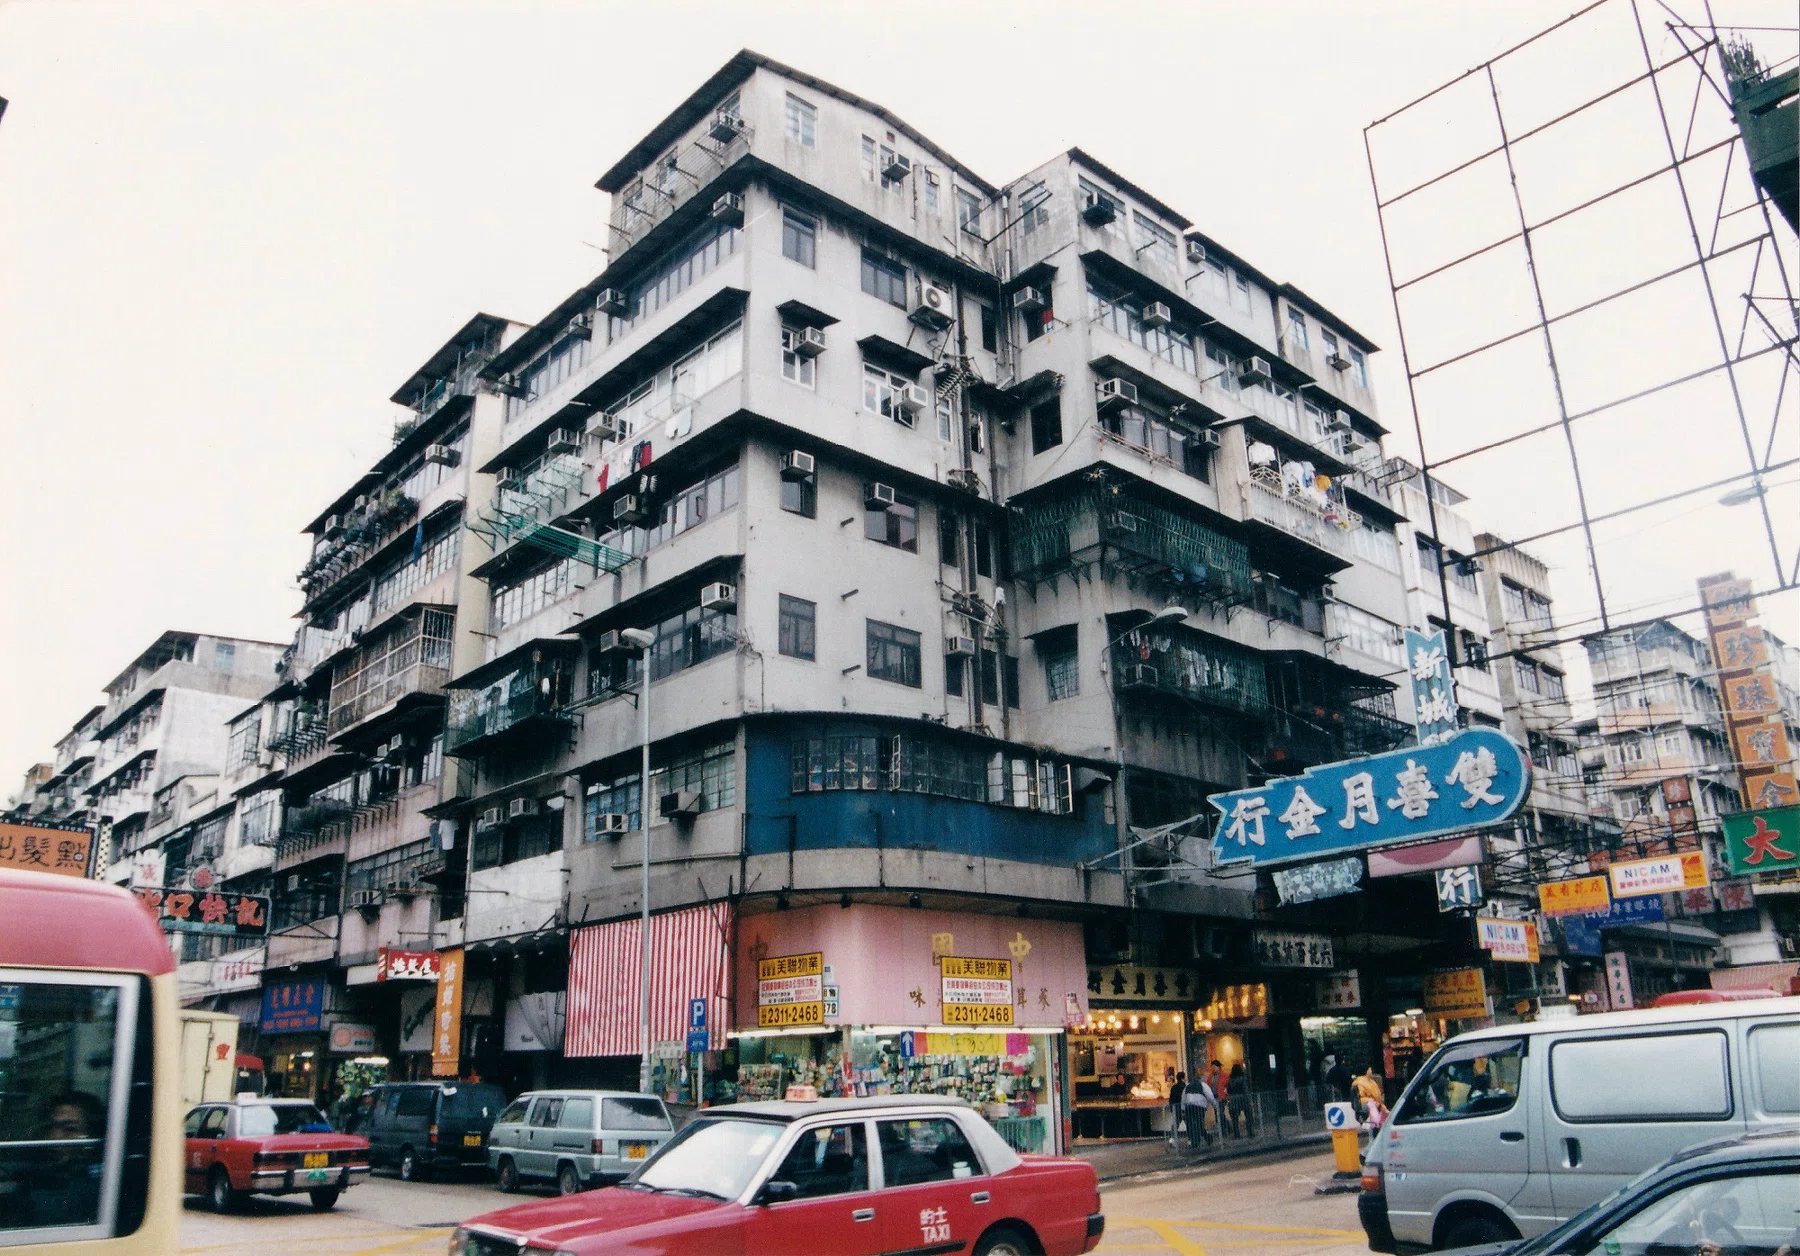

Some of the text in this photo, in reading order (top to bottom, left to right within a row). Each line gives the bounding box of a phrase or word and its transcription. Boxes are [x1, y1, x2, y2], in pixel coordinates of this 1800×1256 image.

[1225, 745, 1505, 847] 雙喜月金行
[1743, 815, 1797, 865] 大
[1624, 864, 1670, 878] NICAM
[1486, 924, 1520, 940] NICAM
[777, 956, 818, 975] 美聯物業
[963, 960, 1007, 976] 美聯物業
[693, 1001, 704, 1025] P
[920, 1206, 948, 1225] 的士
[920, 1224, 951, 1244] TAXI
